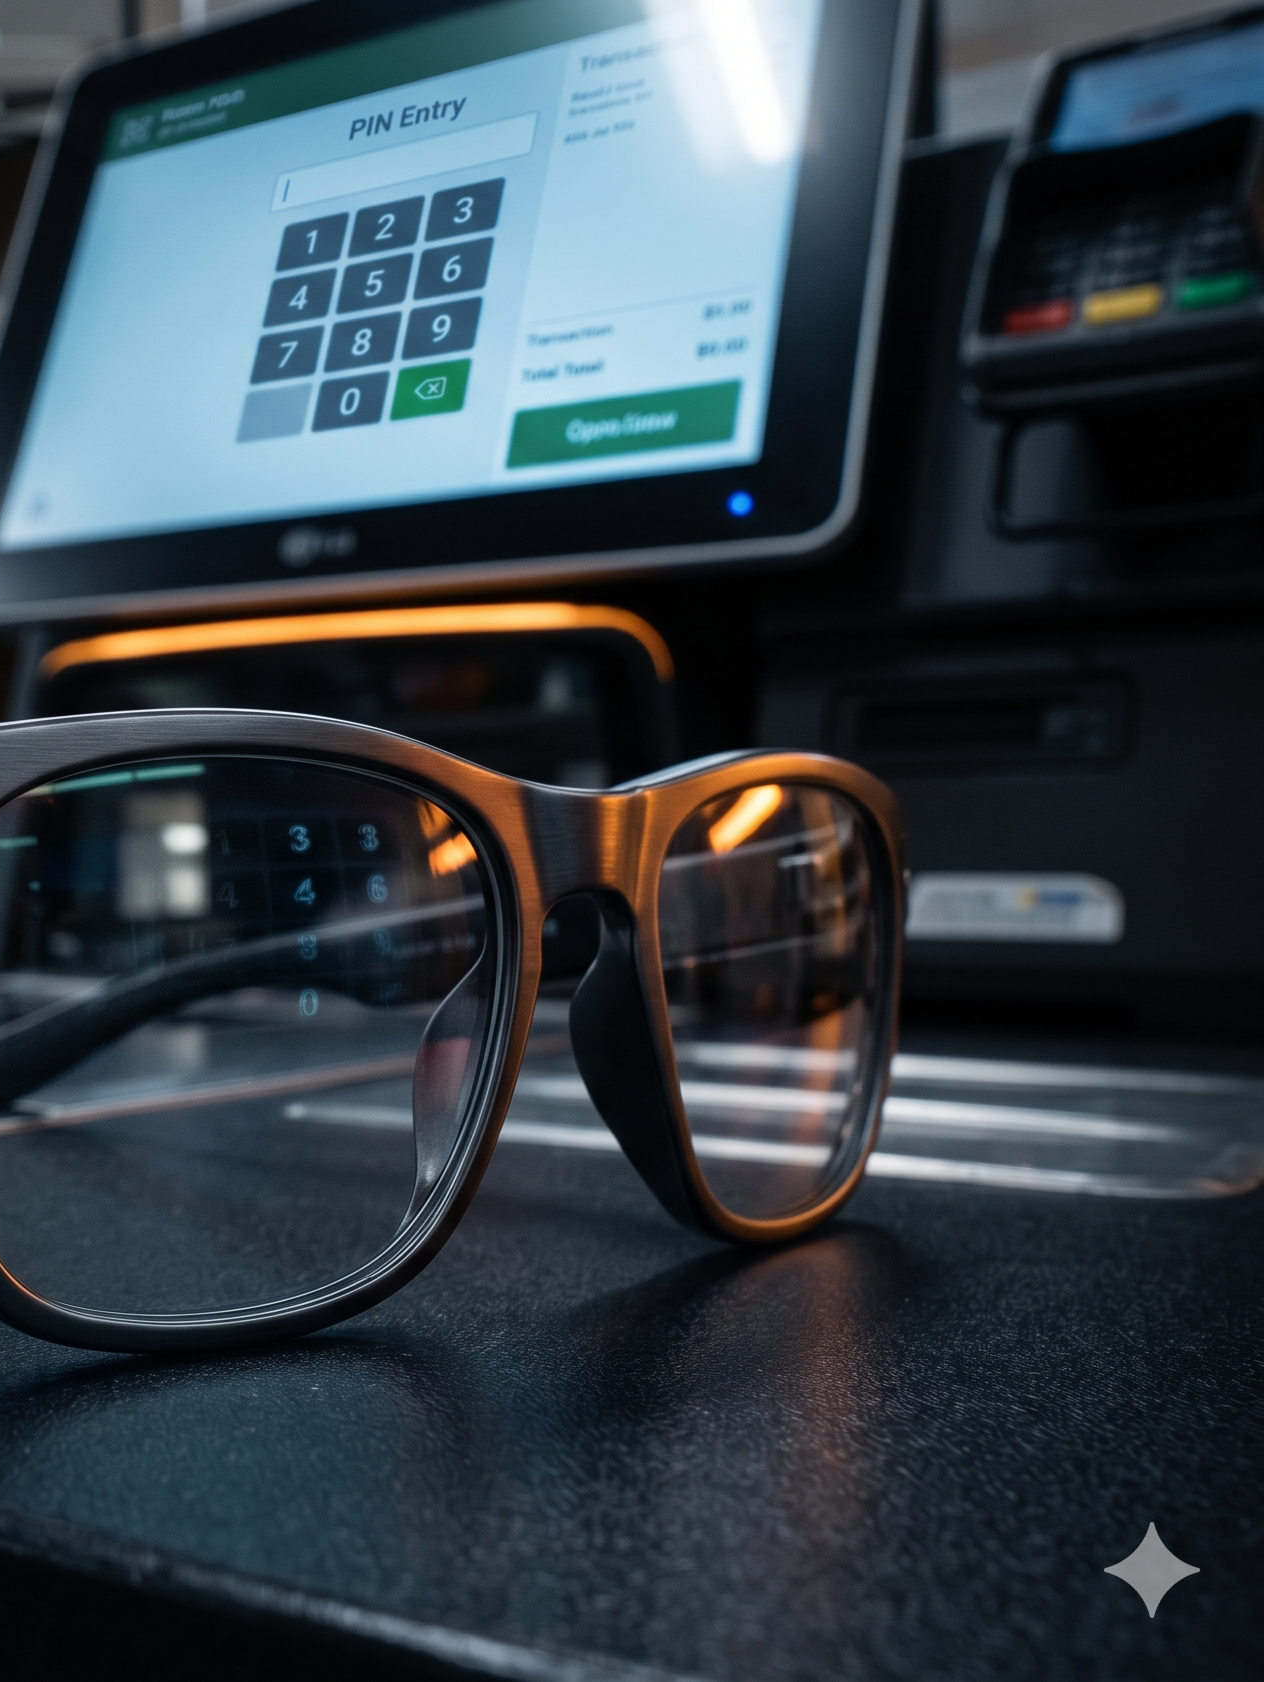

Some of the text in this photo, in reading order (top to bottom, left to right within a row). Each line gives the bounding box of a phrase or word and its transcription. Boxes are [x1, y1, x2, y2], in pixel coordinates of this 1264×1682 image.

[349, 97, 467, 140] PIN Entry
[306, 197, 474, 254] 1 2 3
[288, 255, 462, 310] 4 5 6
[278, 314, 451, 369] 7 8 9
[339, 388, 360, 416] 0
[367, 874, 388, 904] 6
[299, 989, 319, 1017] 0
